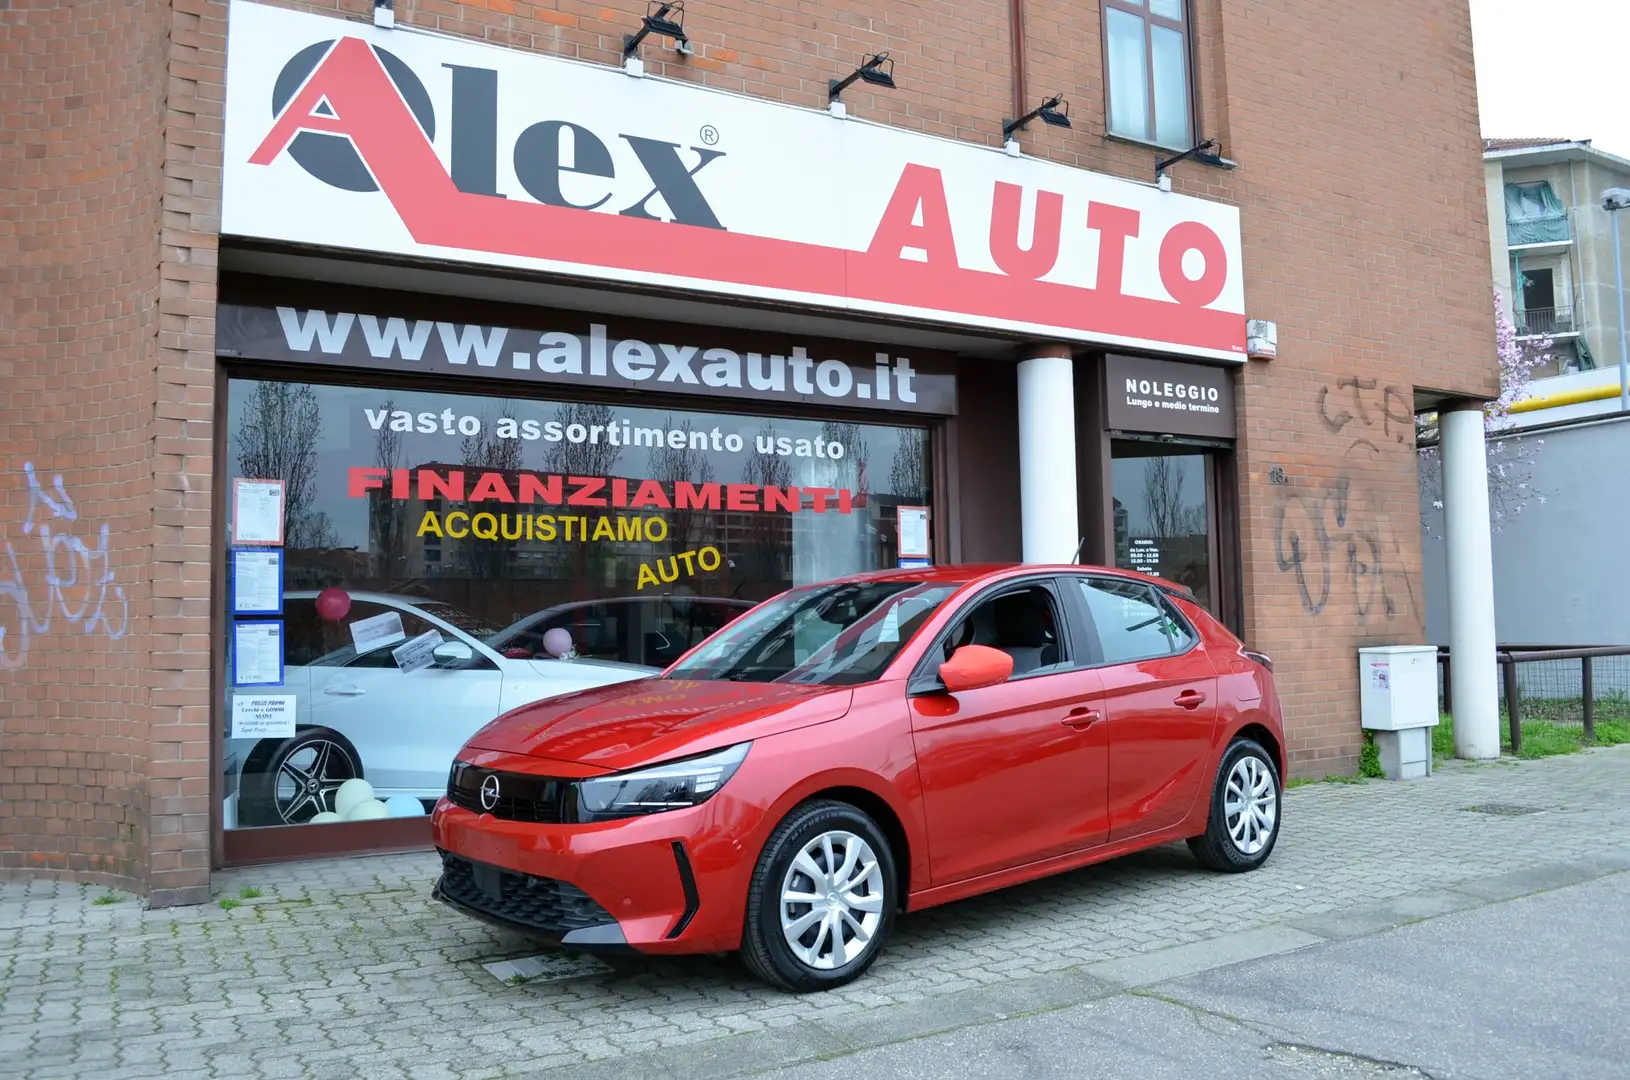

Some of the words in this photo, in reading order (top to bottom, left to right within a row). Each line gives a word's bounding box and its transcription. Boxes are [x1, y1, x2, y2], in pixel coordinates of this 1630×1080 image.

[866, 162, 1228, 307] AUTO
[276, 305, 917, 404] www.alexauto.it
[1125, 378, 1219, 401] NOLEGGIO
[1126, 396, 1152, 408] Lungo
[1161, 401, 1187, 410] medio
[1188, 402, 1220, 414] termine
[364, 408, 481, 436] vasto
[496, 415, 744, 453] assortimento
[756, 434, 845, 459] usato
[347, 466, 853, 515] FINANZIAMENTI
[416, 511, 669, 543] ACQUISTIAMO
[637, 546, 721, 590] AUTO
